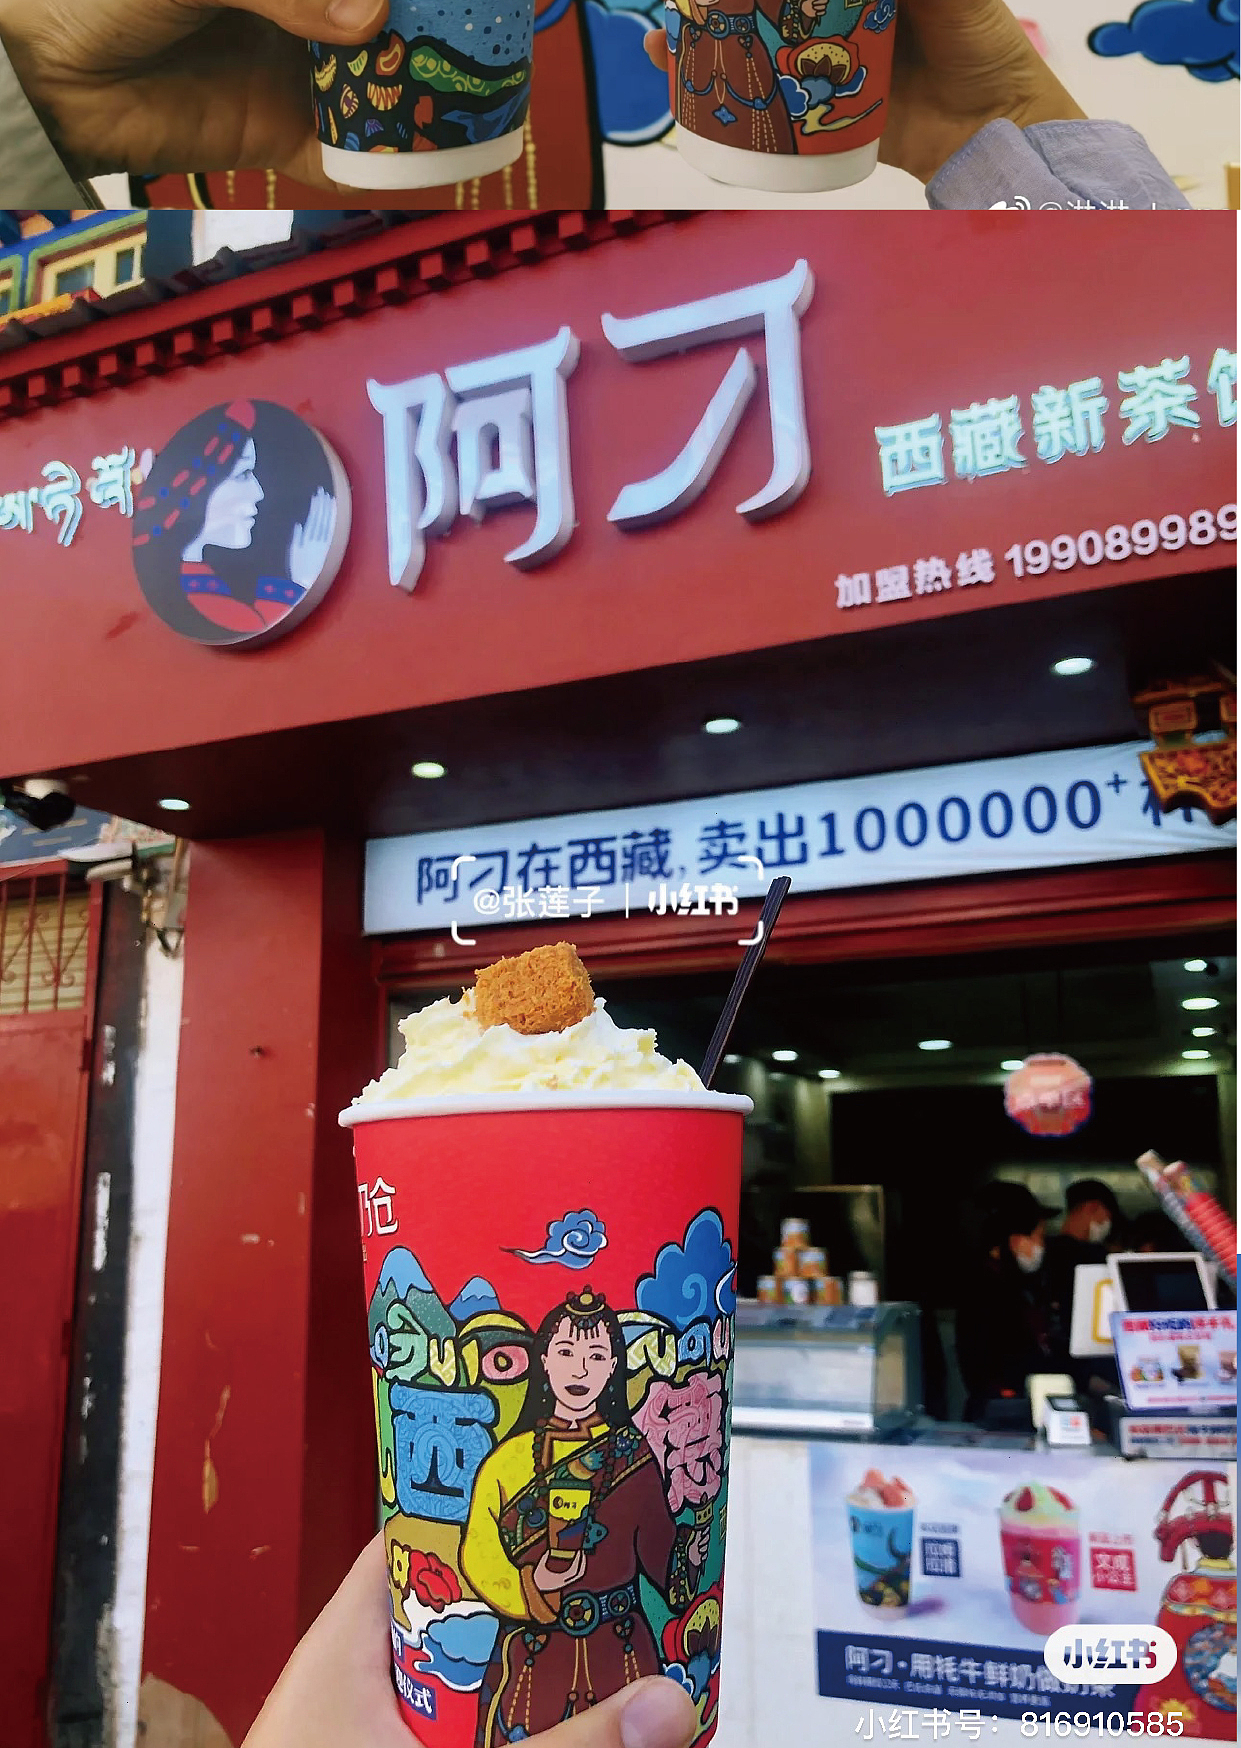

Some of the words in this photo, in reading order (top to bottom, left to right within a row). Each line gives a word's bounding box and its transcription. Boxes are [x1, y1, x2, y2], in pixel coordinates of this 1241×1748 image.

[366, 258, 816, 593] 阿刁
[834, 548, 996, 610] 加盟热线
